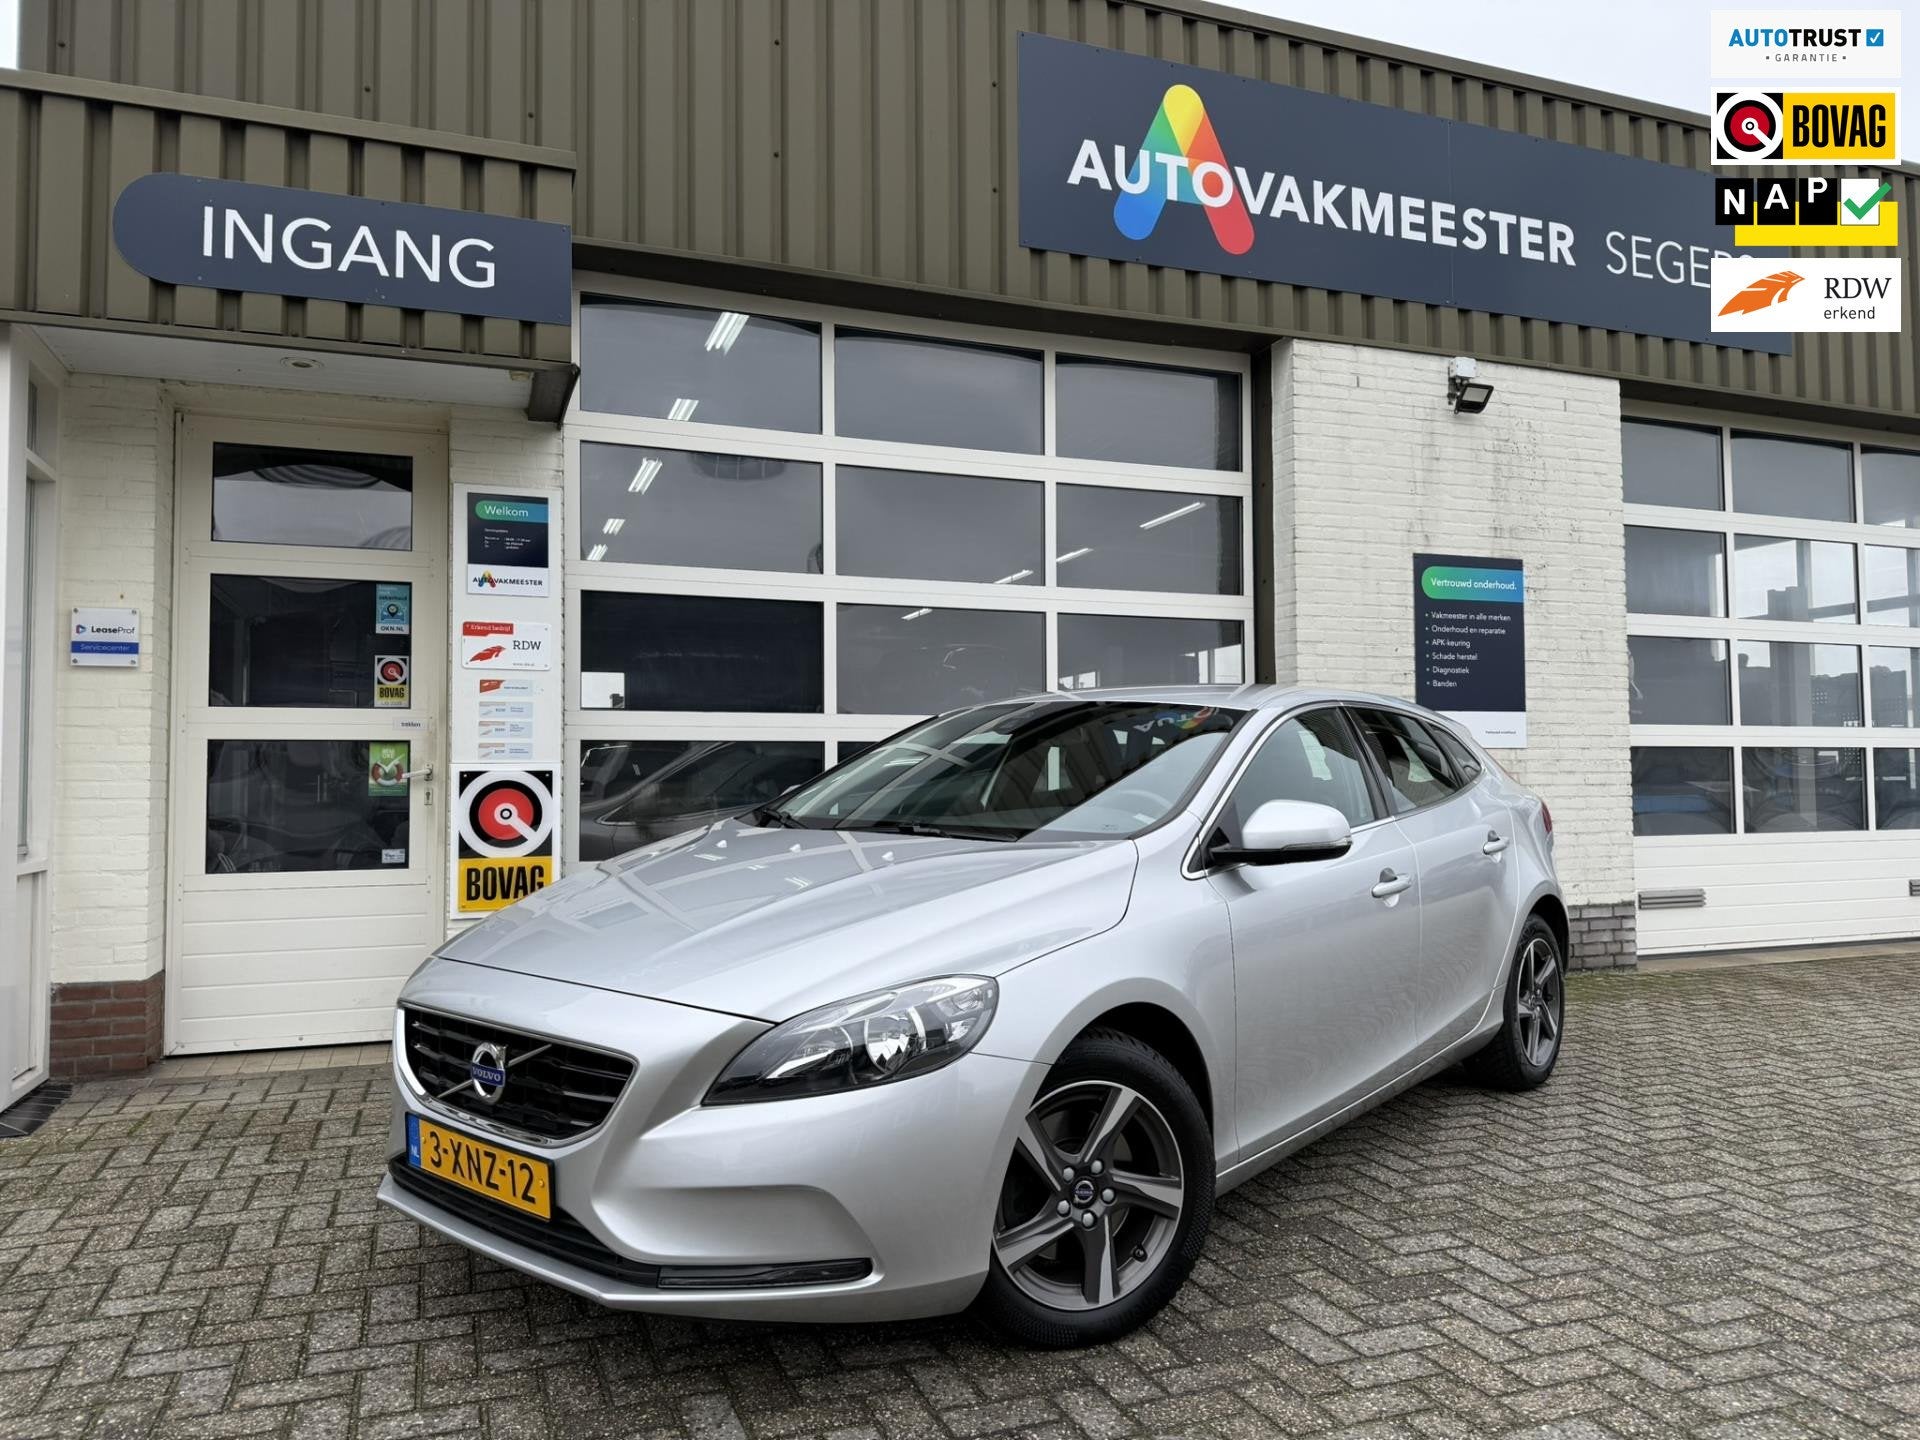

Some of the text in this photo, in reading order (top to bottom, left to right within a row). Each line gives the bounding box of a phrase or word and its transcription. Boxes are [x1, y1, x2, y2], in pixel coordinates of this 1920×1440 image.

[1067, 138, 1757, 290] AUTOVAKMEESTER SEGE
[202, 205, 496, 289] INGANG
[484, 505, 529, 518] Welkom
[1430, 577, 1517, 591] Vertrouwd onderhoud.
[1431, 611, 1511, 622] Vakmeester in alle merken
[91, 625, 135, 634] LeaseProf
[1431, 624, 1469, 634] Onderhoud
[1478, 626, 1506, 636] reparatie
[512, 639, 542, 651] RDW
[1432, 652, 1478, 661] Schade herstel
[1432, 665, 1470, 676] Diagnostiek
[1432, 679, 1458, 688] Banden
[379, 687, 405, 699] BOVAG
[466, 864, 545, 901] BOVAG
[472, 1066, 502, 1083] VOLVO
[429, 1130, 537, 1205] 3-XNZ-12
